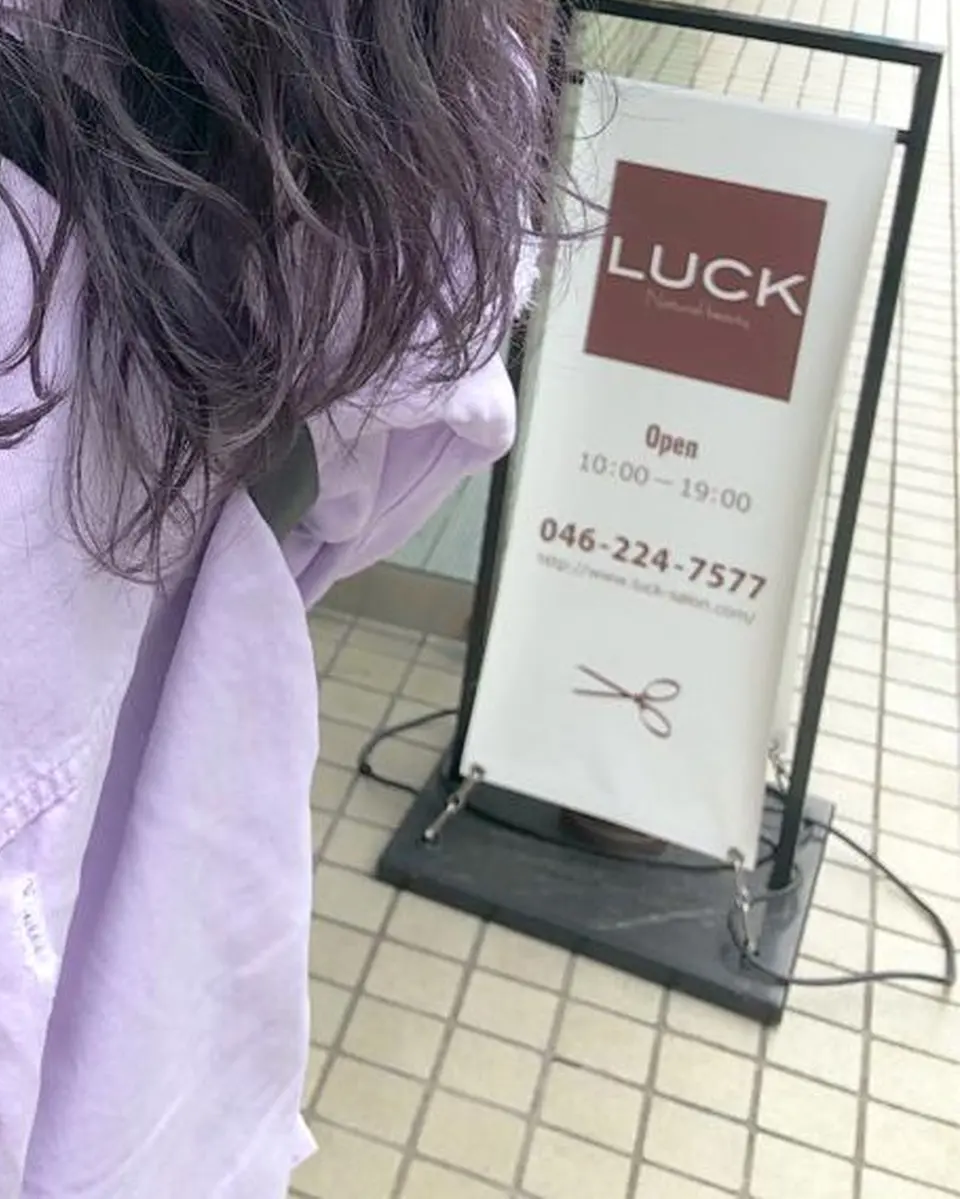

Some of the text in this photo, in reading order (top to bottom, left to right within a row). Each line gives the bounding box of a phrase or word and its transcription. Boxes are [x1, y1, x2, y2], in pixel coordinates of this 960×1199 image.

[607, 235, 806, 316] LUCK
[645, 423, 699, 459] Open
[540, 517, 767, 600] 046-224-7577
